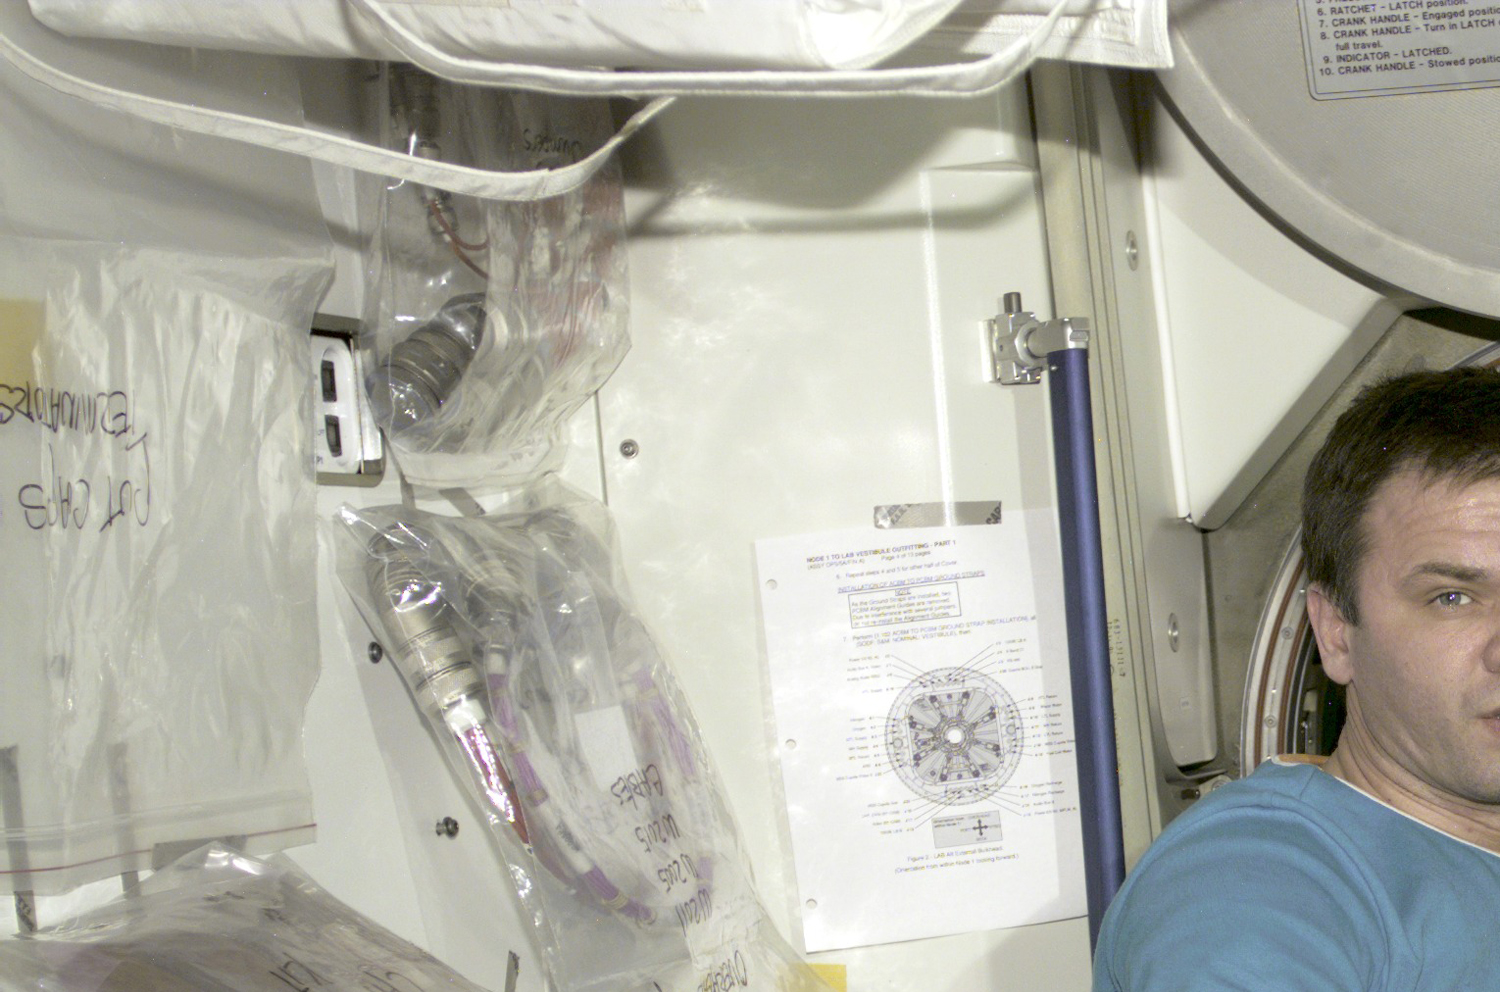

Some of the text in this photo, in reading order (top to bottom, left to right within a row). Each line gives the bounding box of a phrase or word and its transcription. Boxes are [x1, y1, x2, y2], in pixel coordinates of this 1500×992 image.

[1330, 4, 1376, 15] RATCHET
[1388, 1, 1423, 11] LATCH
[1332, 17, 1366, 28] CRANK
[1370, 13, 1410, 25] HANDLE
[1422, 10, 1465, 21] Engaged
[1333, 29, 1367, 40] CRANK
[1371, 25, 1411, 36] HANDLE
[1424, 23, 1446, 32] Turn
[1461, 19, 1495, 29] LATCH
[1335, 42, 1350, 51] full
[1336, 51, 1390, 63] INDICATOR
[1402, 46, 1452, 58] LATCHED.
[1338, 64, 1372, 75] CRANK
[1376, 61, 1416, 72] HANDLE
[1428, 57, 1466, 68] Stowed
[842, 551, 855, 560] LAB
[934, 539, 951, 548] PART
